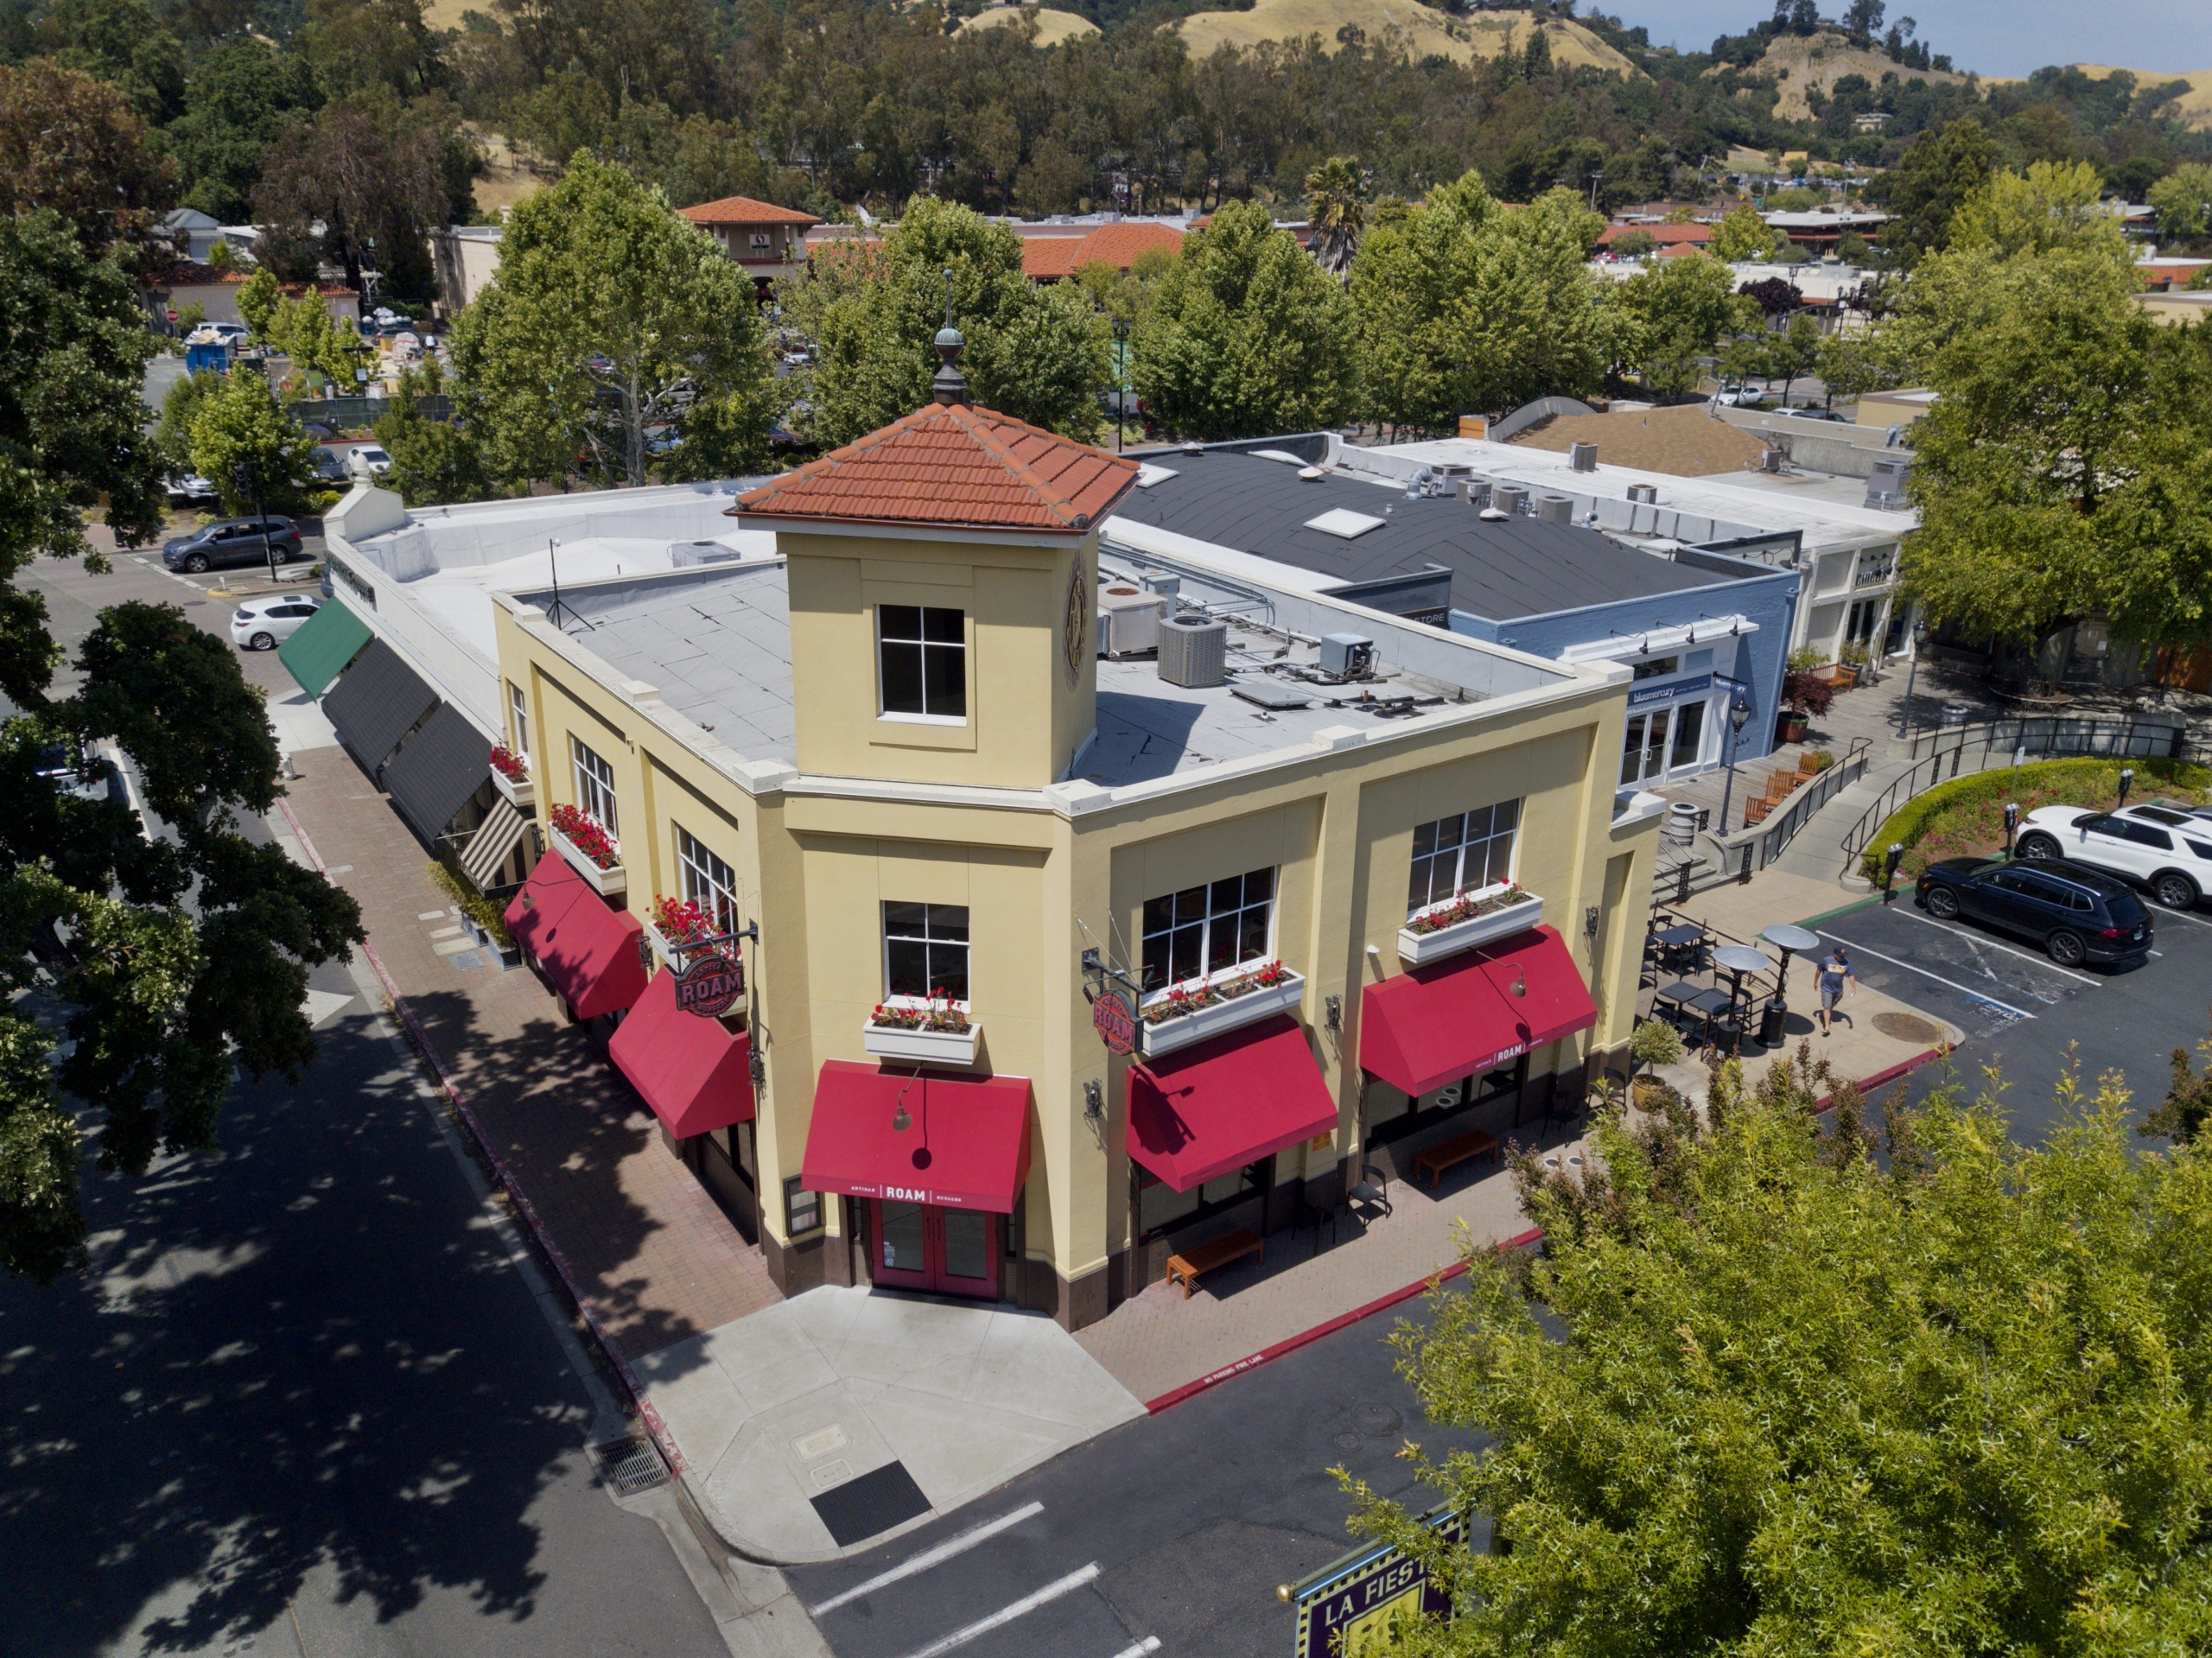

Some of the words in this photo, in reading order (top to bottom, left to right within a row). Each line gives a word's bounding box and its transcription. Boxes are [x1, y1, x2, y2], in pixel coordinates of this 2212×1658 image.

[1633, 687, 1675, 703] bluemercury
[1715, 677, 1745, 693] bluemercury
[682, 972, 741, 1003] ROAM
[1095, 1003, 1134, 1045] ROAM
[1497, 1044, 1522, 1063] ROAM
[887, 1186, 925, 1202] ROAM
[1212, 1367, 1235, 1380] PARKING
[1236, 1361, 1249, 1370] FIRE
[1248, 1354, 1264, 1364] LANE
[1325, 1594, 1354, 1627] LA
[1365, 1557, 1425, 1605] FIEST
